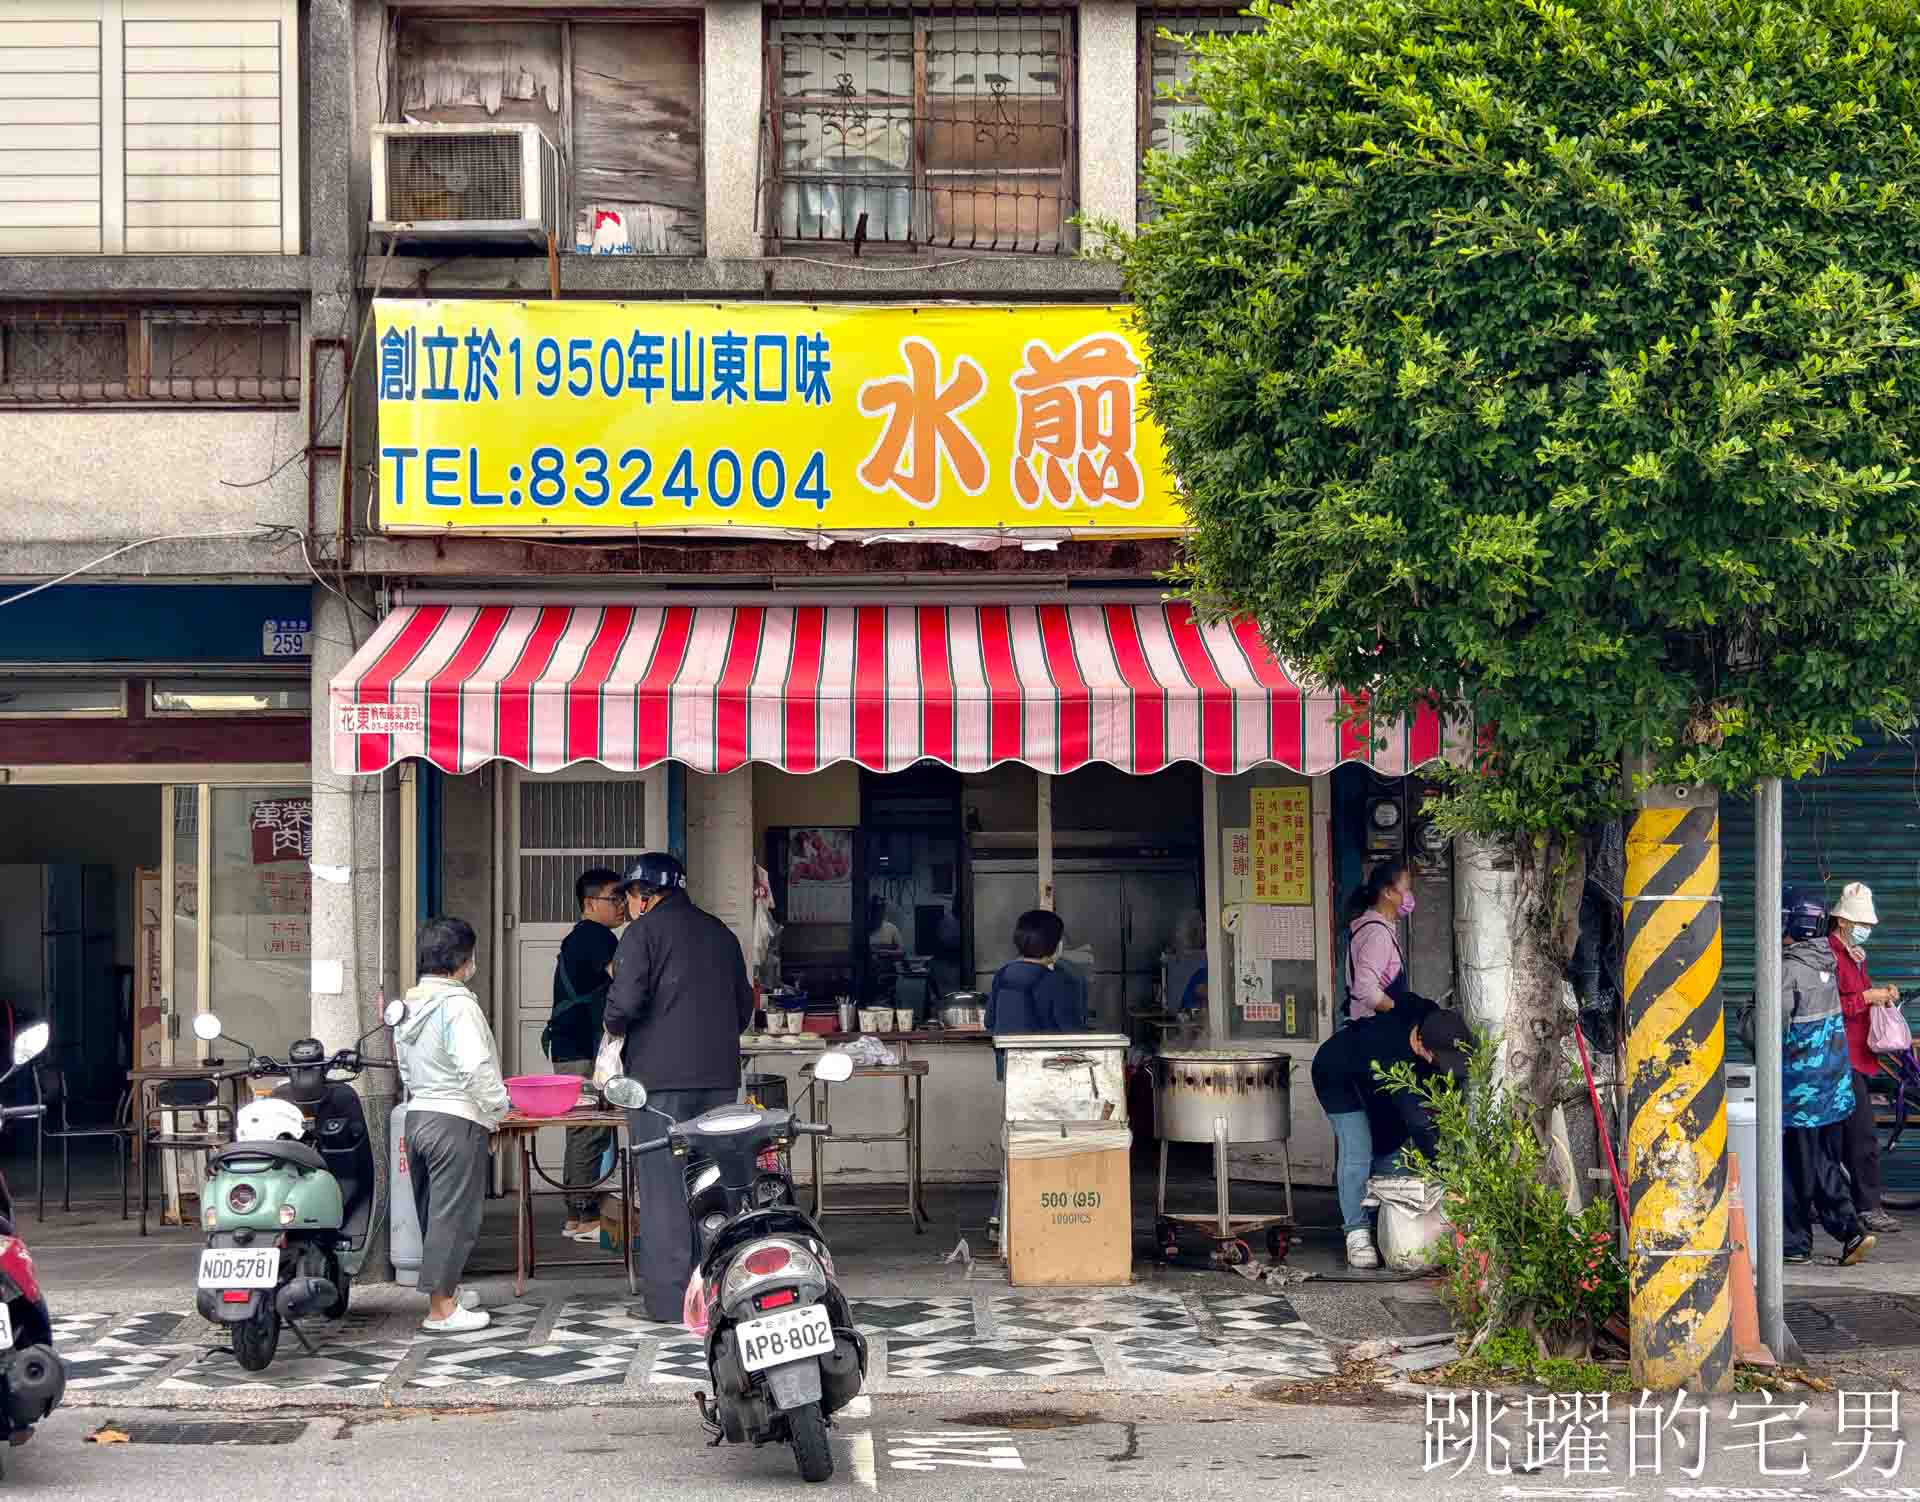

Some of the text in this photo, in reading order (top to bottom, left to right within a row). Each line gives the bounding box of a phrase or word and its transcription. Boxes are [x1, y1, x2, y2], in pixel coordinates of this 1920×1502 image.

[380, 326, 831, 405] 創立於1950年山東口味
[859, 335, 1143, 508] 水煎
[382, 448, 831, 509] TEL:8324004
[273, 633, 303, 655] 259
[340, 705, 371, 733] 花東
[1041, 1192, 1068, 1208] 500
